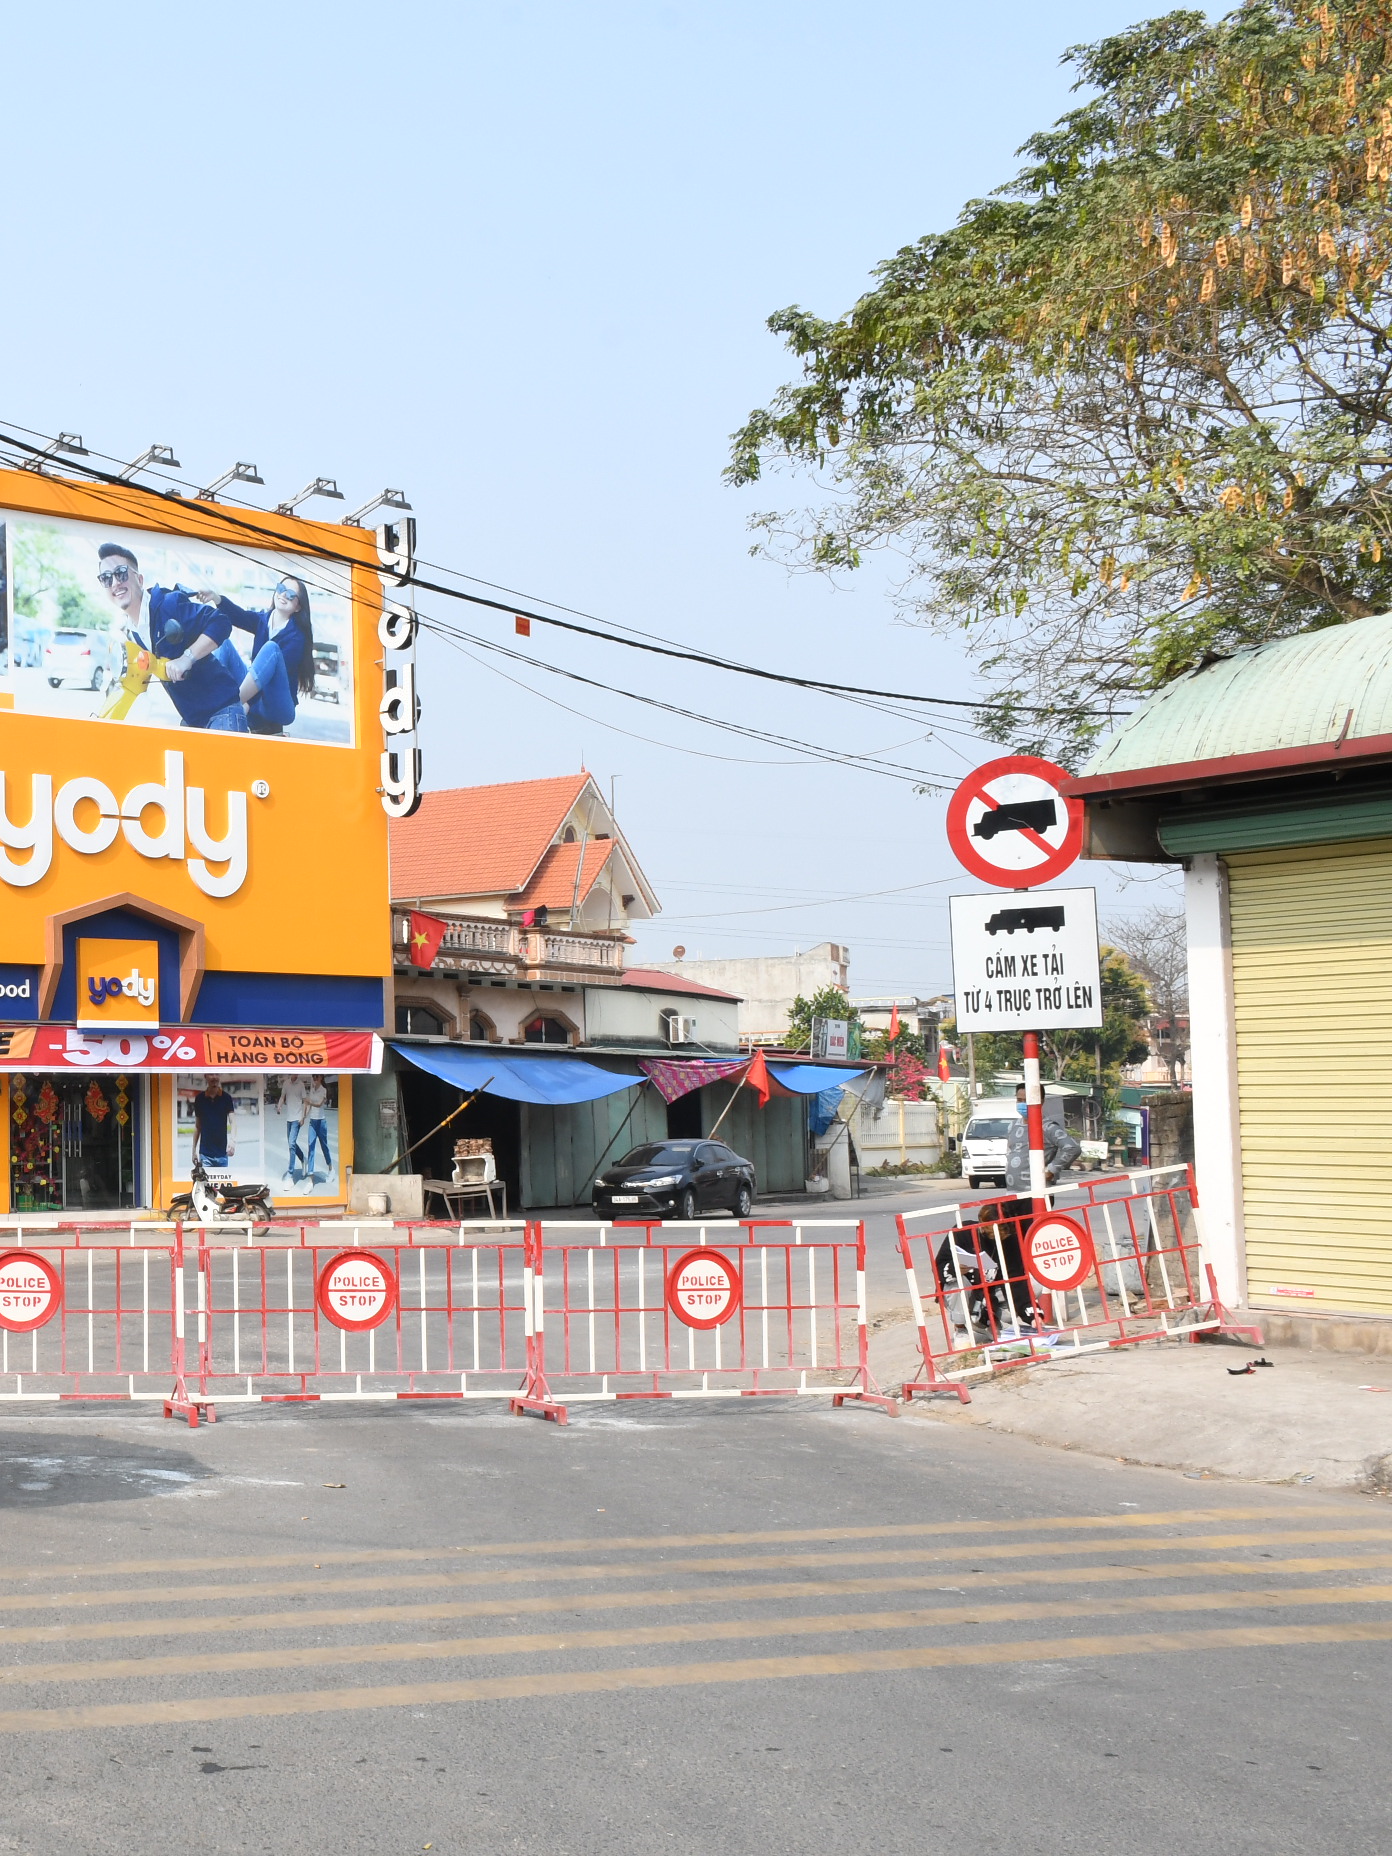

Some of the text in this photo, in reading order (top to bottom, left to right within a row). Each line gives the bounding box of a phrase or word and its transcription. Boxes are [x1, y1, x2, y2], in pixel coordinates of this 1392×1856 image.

[376, 530, 420, 818] yody
[986, 944, 1064, 979] CẤM XE TẢI
[87, 968, 155, 1007] yody
[964, 977, 1093, 1016] TỪ 4 TRỤC TRỞ LÊN
[49, 1029, 196, 1066] -50%
[228, 1034, 304, 1050] TOÀN BỘ
[216, 1050, 323, 1065] HÀNG ĐÔNG
[1035, 1236, 1074, 1252] POLICE
[1043, 1255, 1074, 1269] STOP
[334, 1277, 380, 1287] POLICE
[682, 1276, 725, 1286] POLICE
[2, 1296, 42, 1307] STOP
[339, 1295, 377, 1306] STOP
[687, 1294, 722, 1305] STOP
